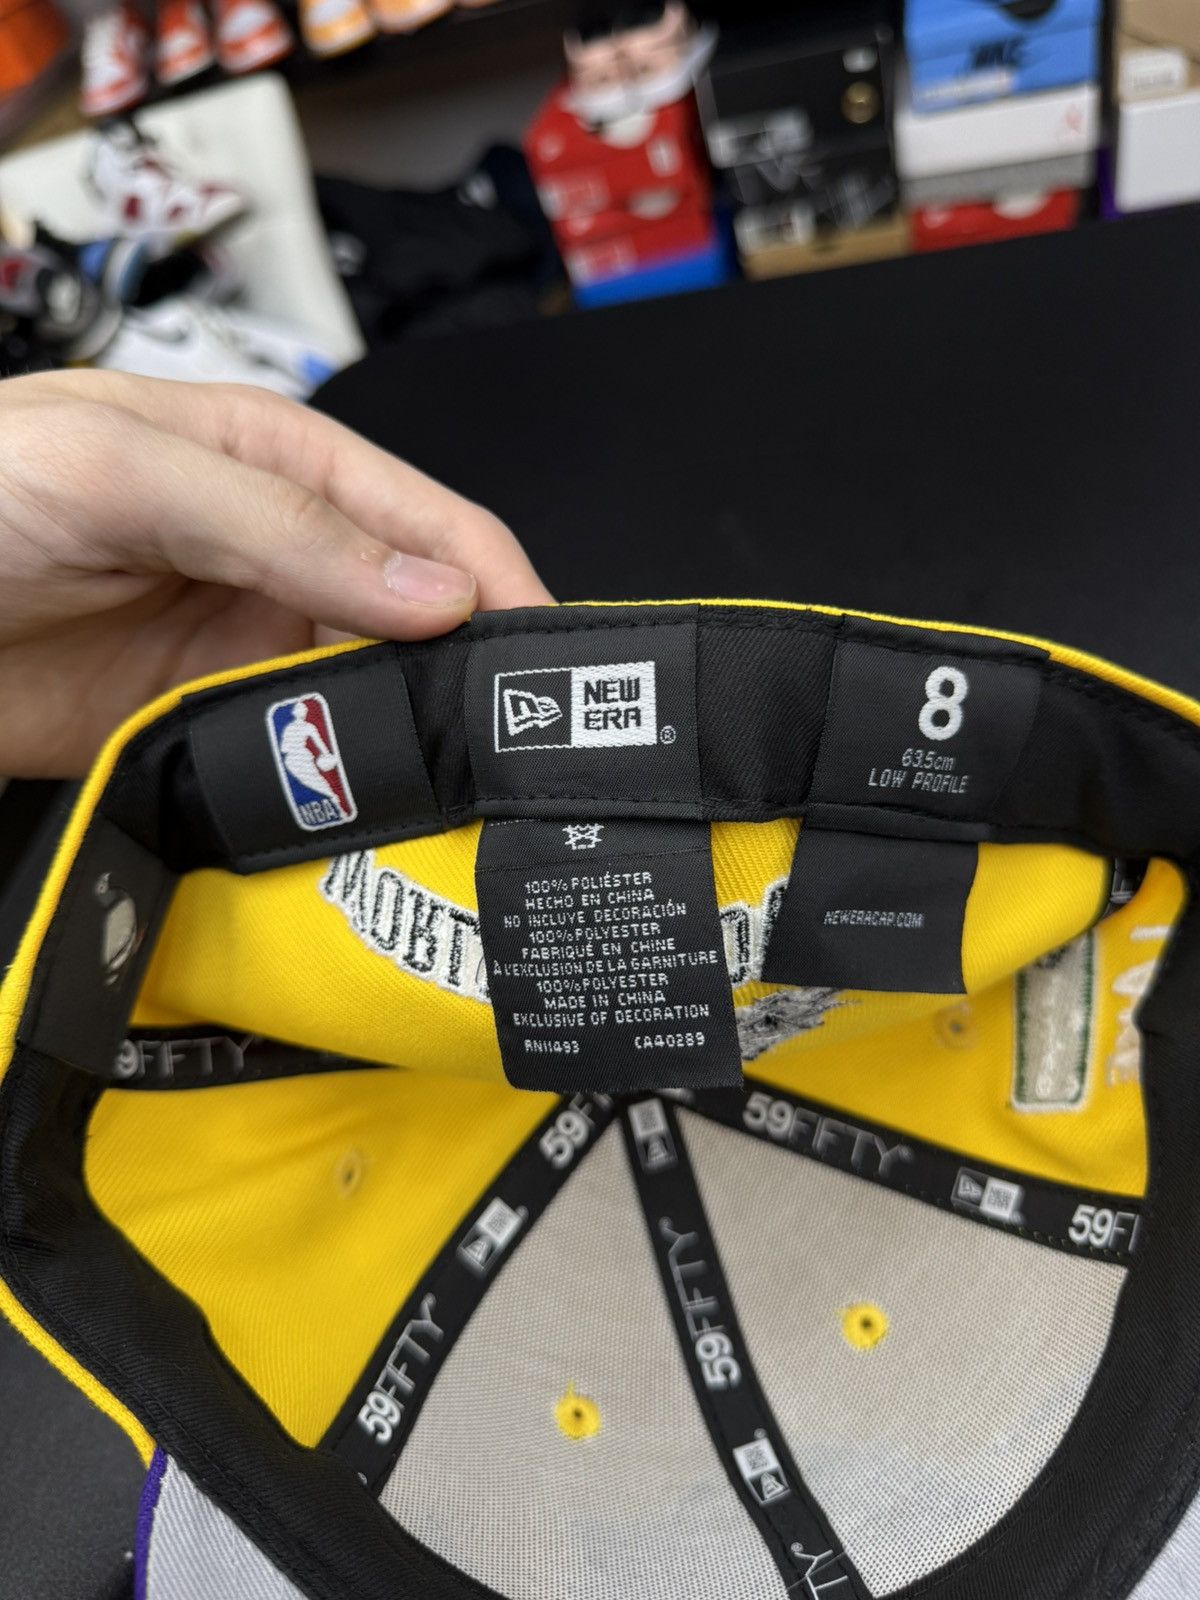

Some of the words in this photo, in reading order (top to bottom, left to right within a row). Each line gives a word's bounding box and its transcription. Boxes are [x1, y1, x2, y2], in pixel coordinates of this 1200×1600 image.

[584, 676, 641, 706] NEW
[918, 665, 968, 740] 8
[584, 706, 642, 731] ERA
[868, 767, 907, 788] LOW
[912, 771, 971, 794] PROFILE
[298, 797, 338, 825] NBA
[525, 879, 568, 894] 100%
[571, 871, 652, 890] POLIÉSTER
[525, 895, 574, 910] HECHO
[581, 893, 600, 906] EN
[608, 888, 655, 904] CHINA
[504, 915, 521, 928] NO
[528, 911, 585, 927] INCLUYE
[594, 899, 686, 922] DECORACIÓN
[823, 910, 926, 928] NEWERACAP.COM
[529, 930, 573, 943] 100%
[575, 922, 661, 941] POLYESTER
[522, 941, 595, 960] FABRIQUÉ
[601, 942, 621, 955] EN
[630, 937, 676, 954] CHINE
[493, 959, 502, 975] À
[504, 961, 582, 976] L'EXCLUSION
[586, 960, 604, 974] DE
[608, 959, 627, 972] LA
[631, 950, 719, 970] GARNITURE
[536, 979, 580, 993] 100%
[582, 972, 669, 991] POLYESTER
[544, 995, 587, 1010] MADE
[592, 994, 609, 1008] IN
[618, 990, 666, 1006] CHINA
[513, 1012, 586, 1027] EXCLUSIVE
[590, 1011, 608, 1025] OF
[615, 1004, 710, 1023] DECORATION
[524, 1039, 580, 1054] RN11493
[634, 1031, 706, 1049] CA40289
